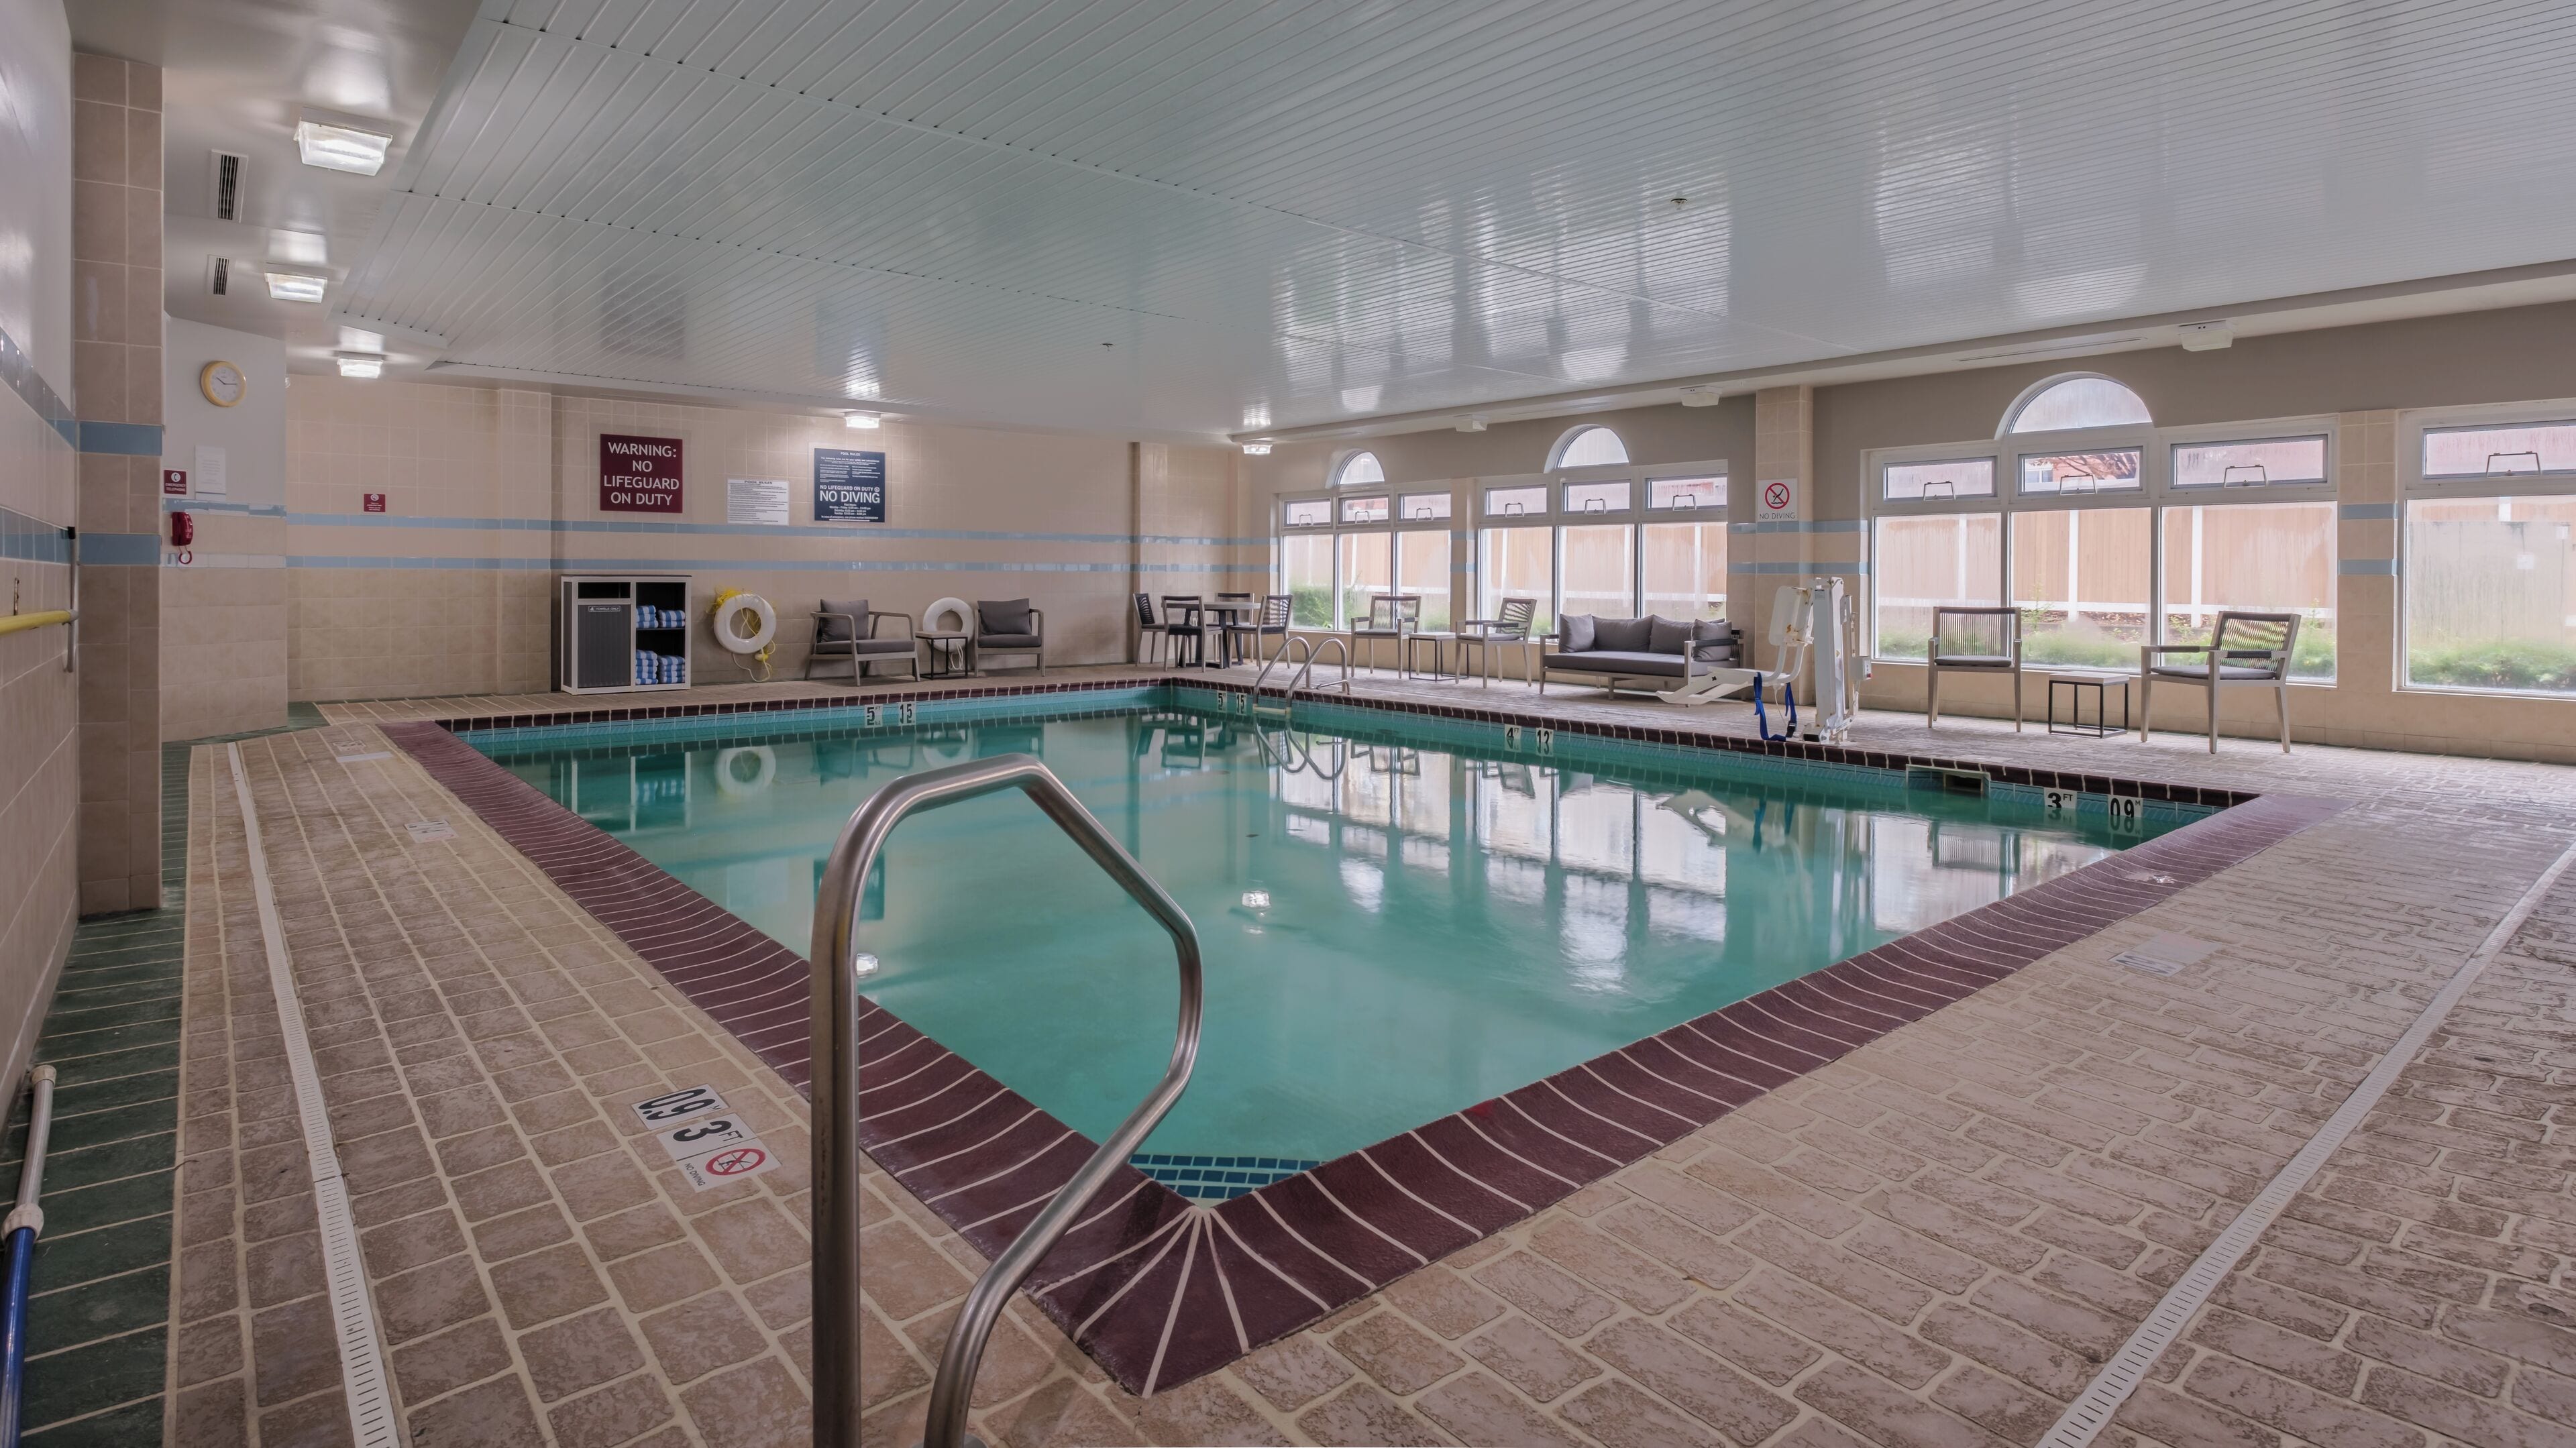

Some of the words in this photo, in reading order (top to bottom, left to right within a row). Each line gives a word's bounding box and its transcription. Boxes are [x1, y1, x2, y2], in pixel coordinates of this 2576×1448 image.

[608, 442, 676, 457] WARNING:
[633, 460, 653, 472] NO
[604, 475, 680, 490] LIFEGUARD
[610, 492, 631, 504] ON
[636, 493, 673, 506] DUTY
[820, 490, 837, 502] NO
[841, 491, 880, 504] DIVING
[1507, 727, 1514, 738] 4
[2047, 792, 2061, 808] 3
[2063, 793, 2073, 801] FT
[673, 1121, 732, 1141] 3
[718, 1130, 743, 1141] FT
[684, 1163, 694, 1172] NO
[689, 1170, 706, 1187] DIVING
